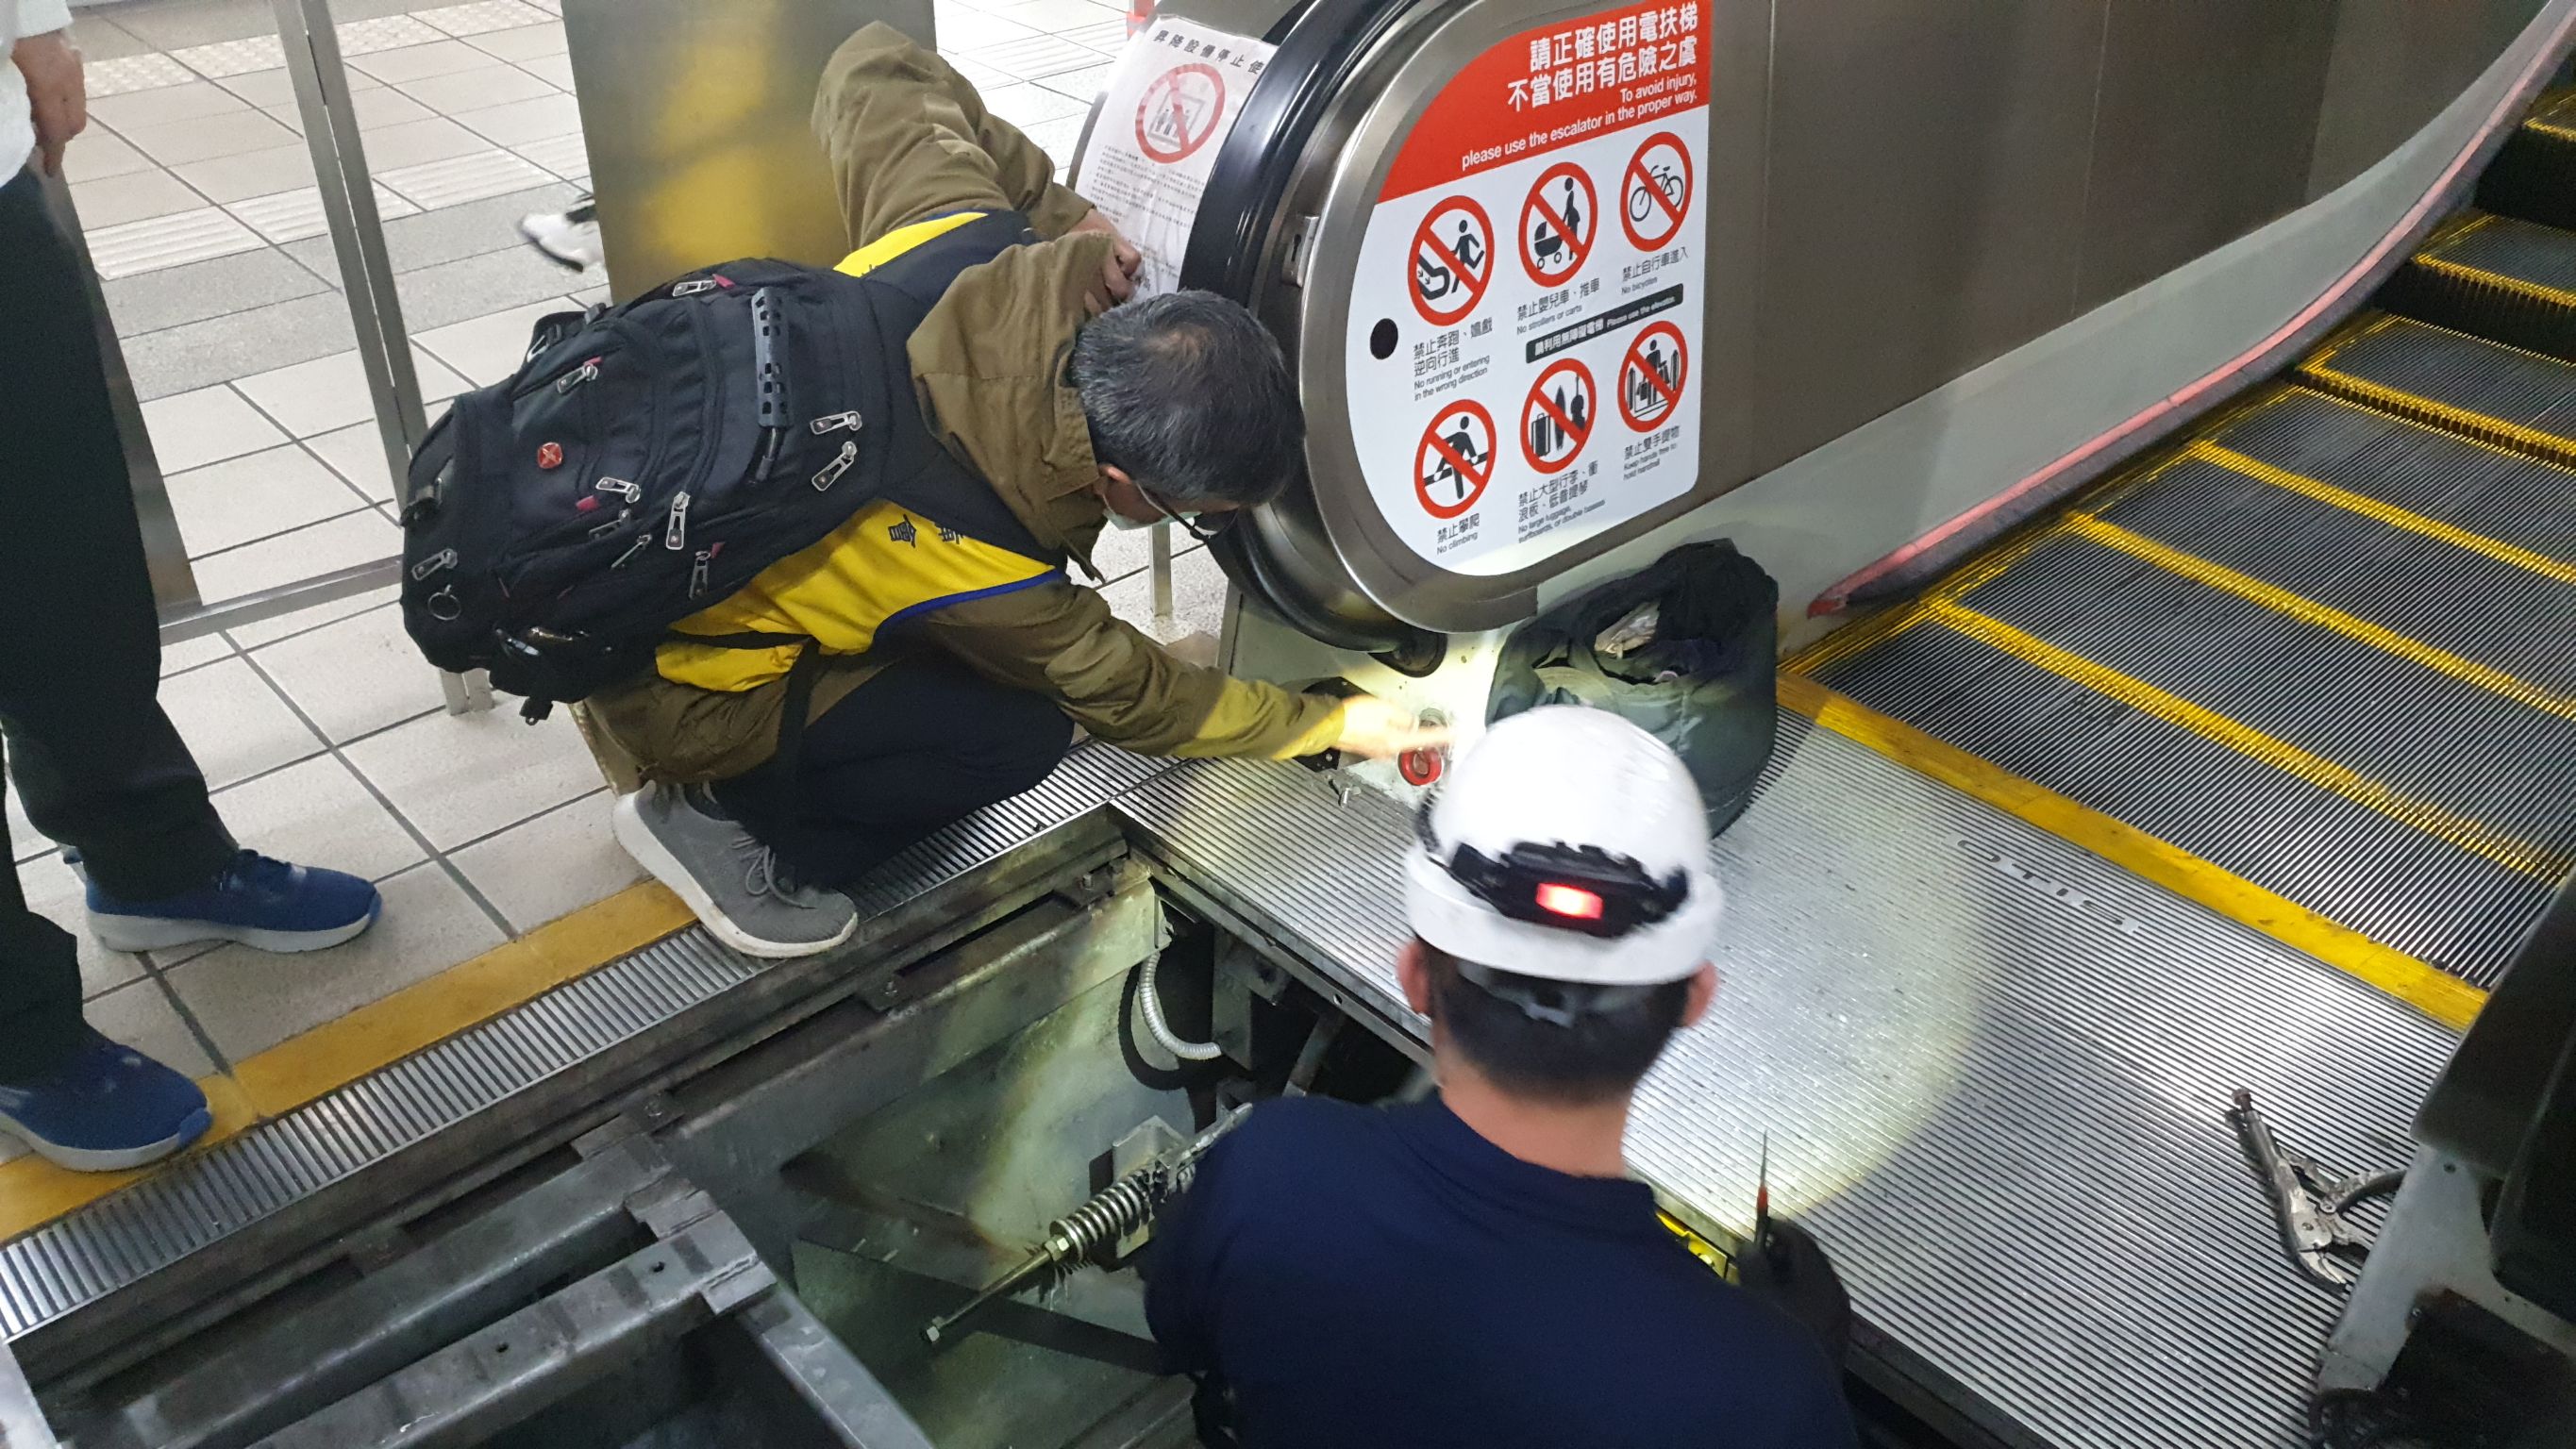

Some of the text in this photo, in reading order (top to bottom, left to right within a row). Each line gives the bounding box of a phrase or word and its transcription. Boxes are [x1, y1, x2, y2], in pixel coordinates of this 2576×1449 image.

[1530, 1, 1698, 73] 請正確使用電扶梯
[1507, 35, 1698, 112] 不當使用有危險之虞
[1620, 73, 1698, 103] To avoid injury,
[1462, 89, 1698, 172] please use the escalator in the proper way.
[1621, 286, 1631, 295] No
[1517, 325, 1528, 336] No
[1557, 311, 1564, 321] or
[1414, 346, 1460, 377] 逆向行進
[1414, 355, 1490, 390] No running or entering
[1414, 367, 1488, 402] in the wrong direction
[1518, 525, 1528, 534] No
[1437, 545, 1447, 555] No
[1957, 839, 2125, 925] OTIS
